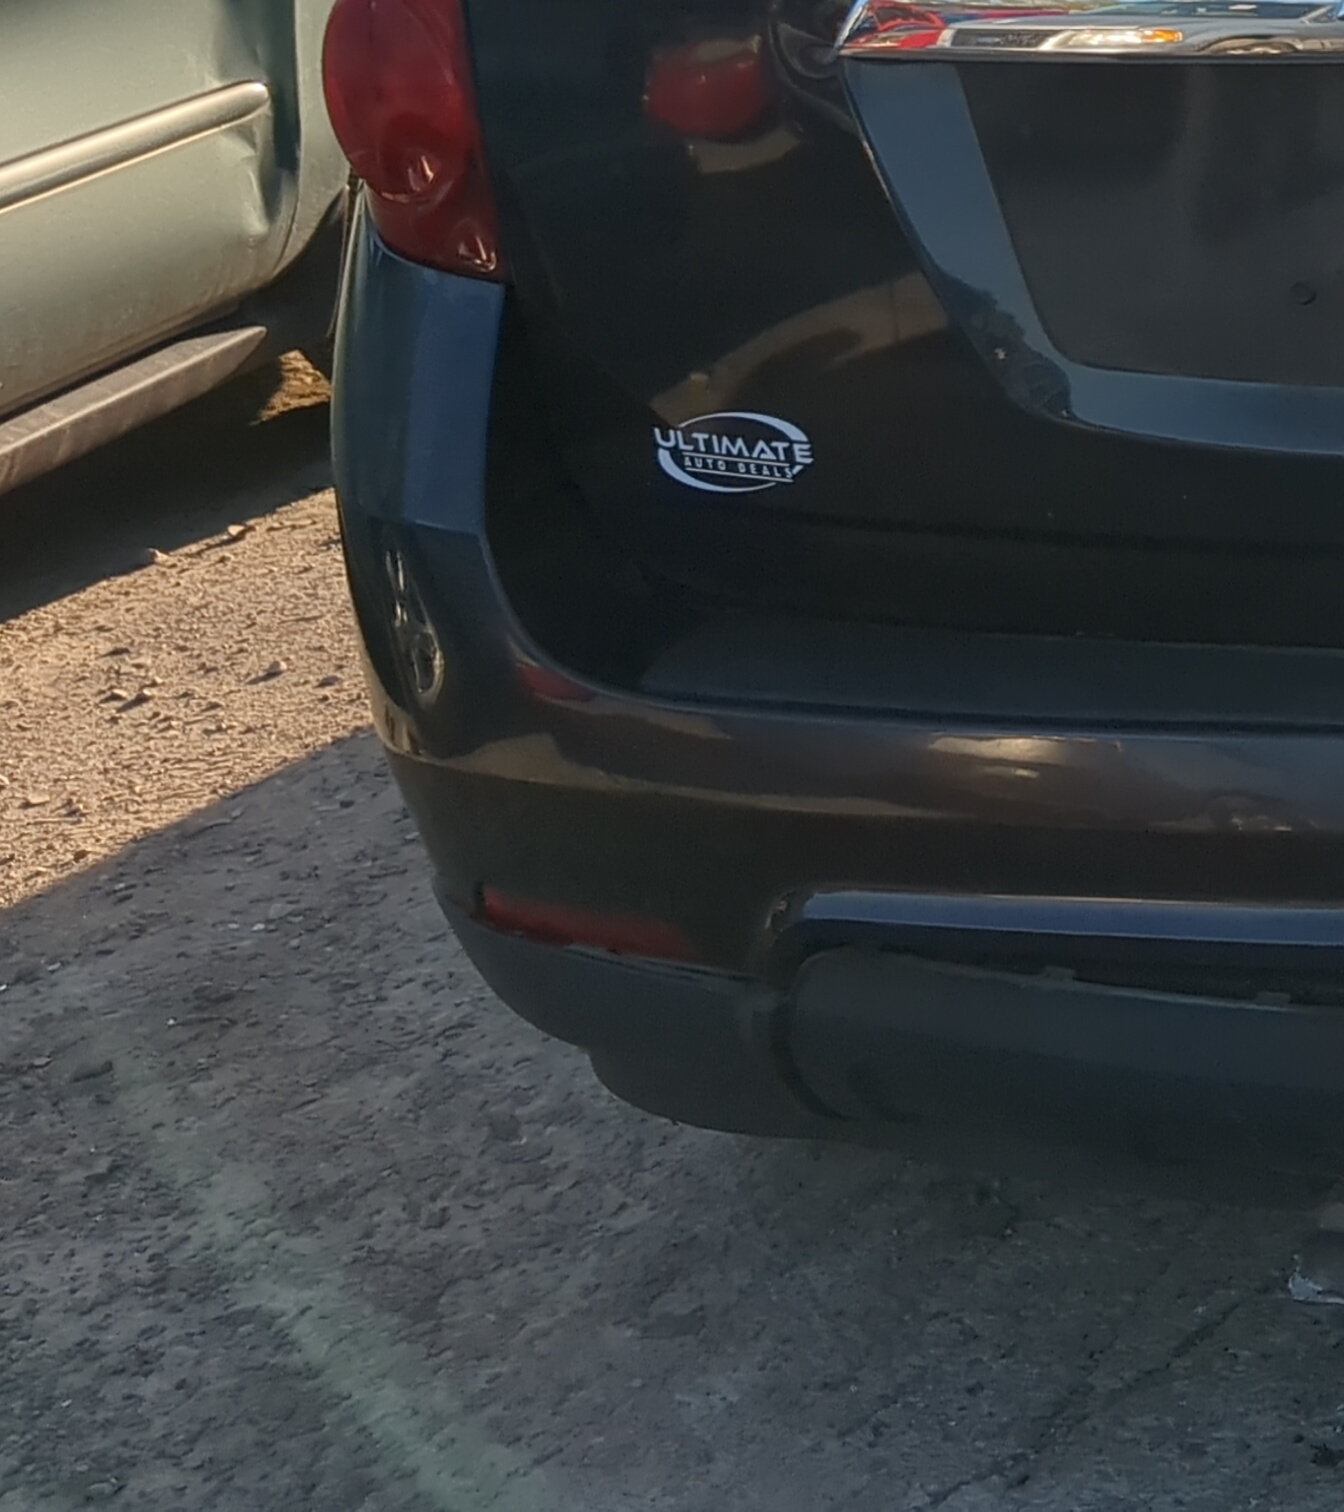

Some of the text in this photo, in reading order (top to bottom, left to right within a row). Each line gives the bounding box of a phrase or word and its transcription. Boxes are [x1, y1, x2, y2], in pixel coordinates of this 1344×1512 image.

[653, 427, 814, 464] ULTIMATE
[683, 455, 794, 479] AUTO DEALS
